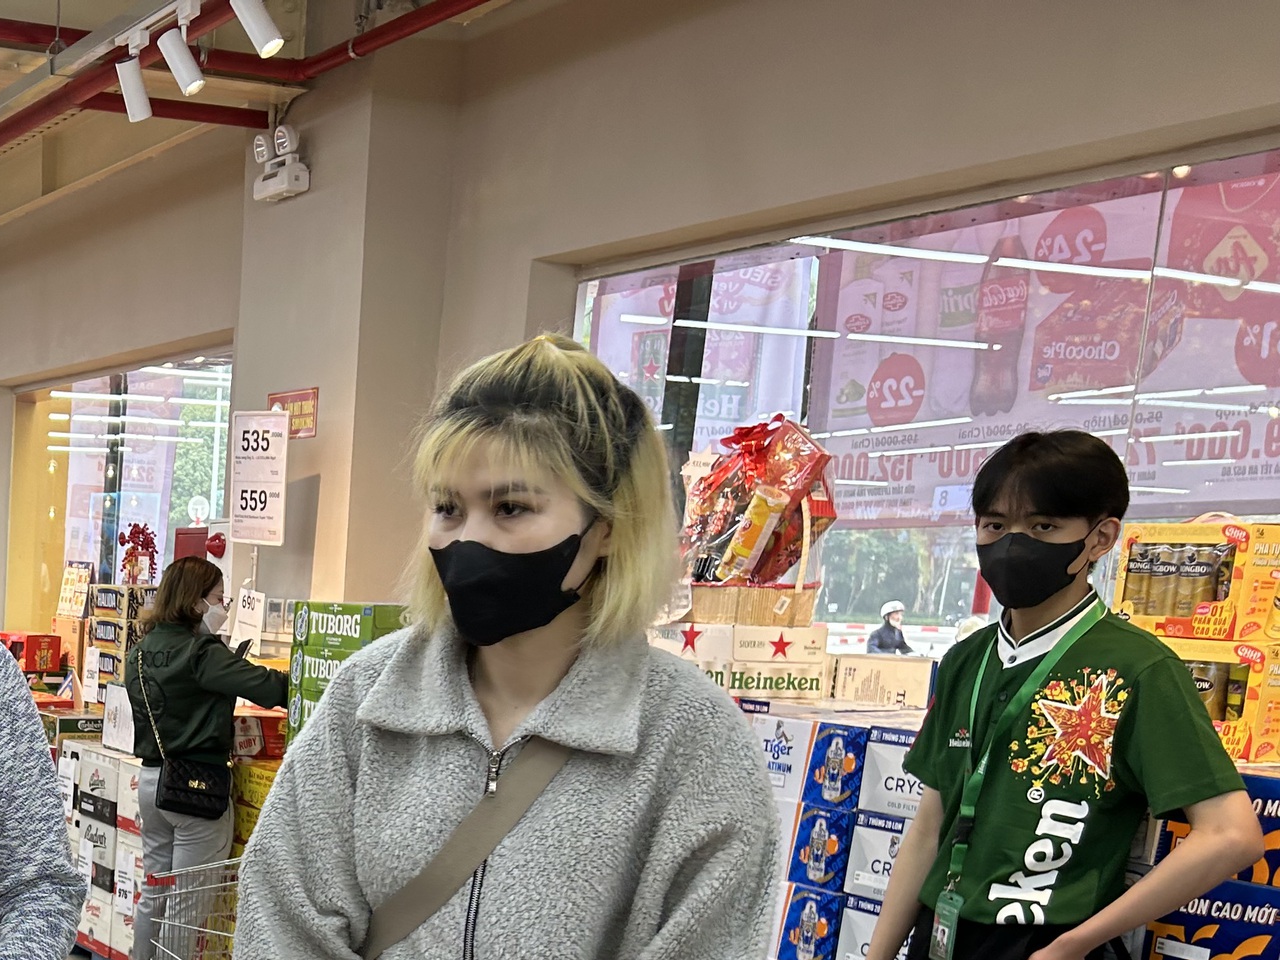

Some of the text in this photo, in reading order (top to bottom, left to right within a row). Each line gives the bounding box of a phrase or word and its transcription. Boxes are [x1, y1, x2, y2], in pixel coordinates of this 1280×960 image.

[241, 430, 270, 452] 535
[240, 489, 268, 511] 559
[1211, 606, 1224, 617] 01
[310, 611, 361, 638] TUBORG
[730, 671, 820, 692] Heineken
[1223, 724, 1237, 736] 01
[239, 736, 257, 750] RUBY
[763, 739, 793, 761] Tiger
[1211, 900, 1243, 919] CAO
[1244, 904, 1278, 925] MỚI
